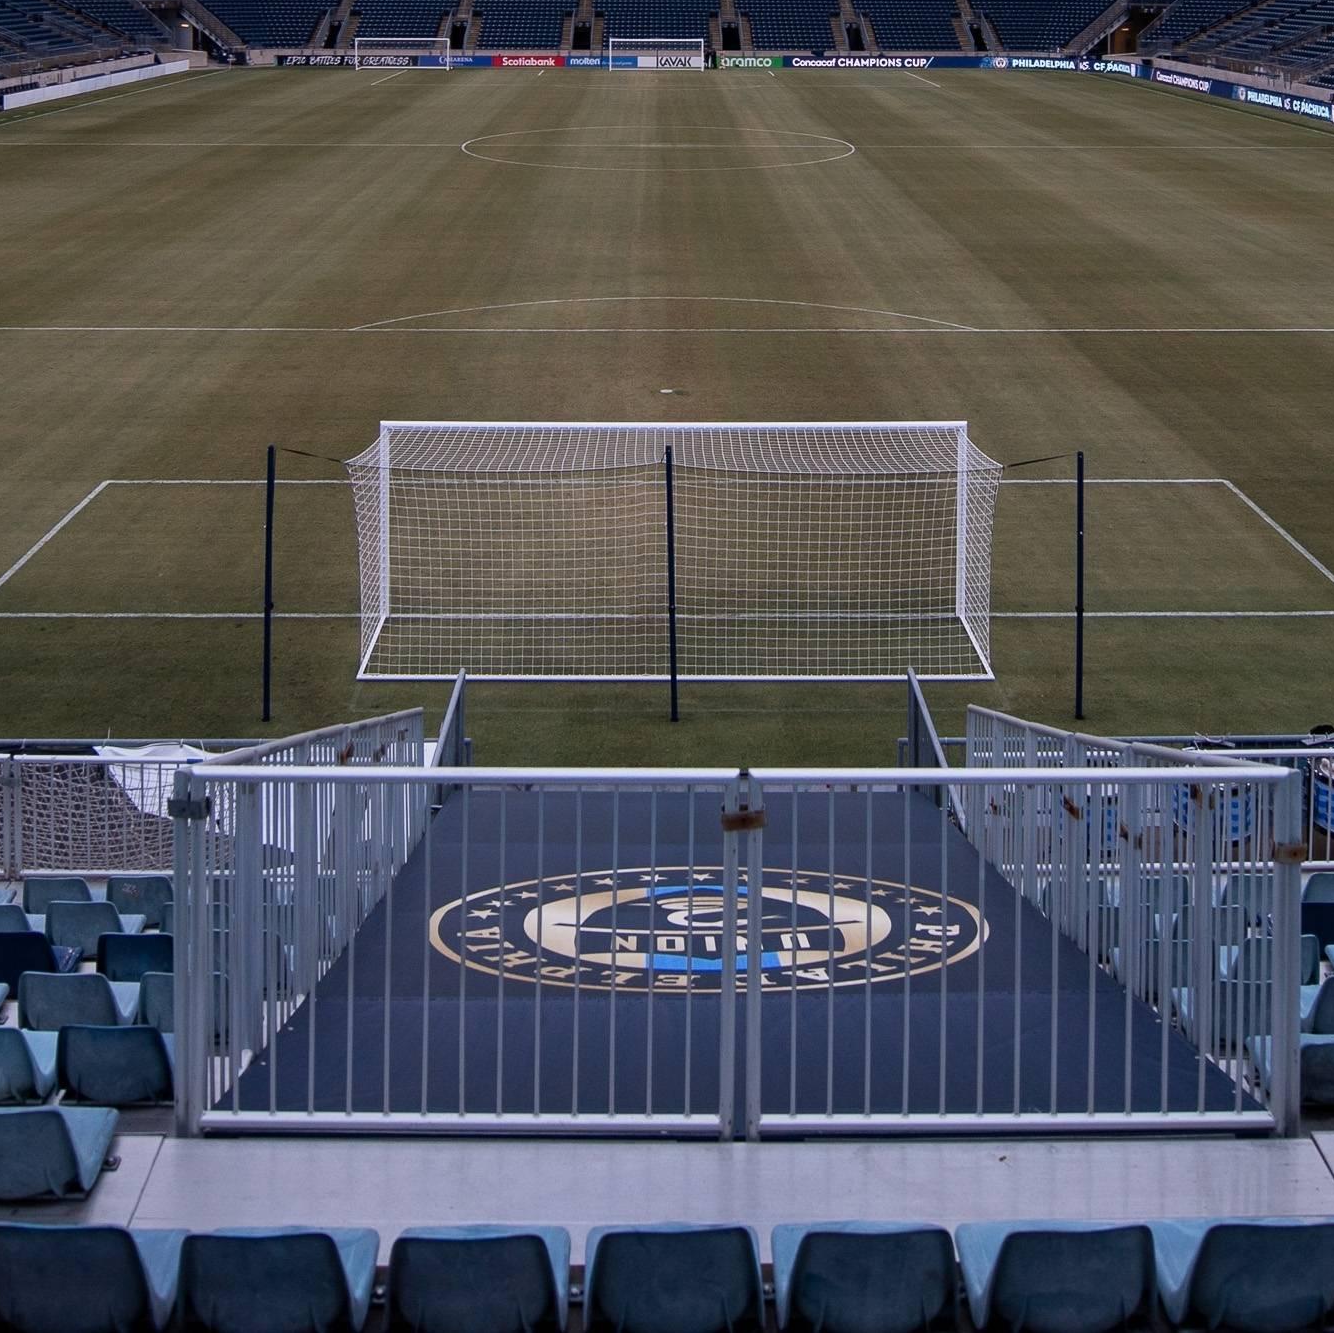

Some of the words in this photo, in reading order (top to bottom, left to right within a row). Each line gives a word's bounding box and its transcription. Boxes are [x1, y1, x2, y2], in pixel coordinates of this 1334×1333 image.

[285, 55, 307, 66] EPIC
[502, 56, 556, 66] Scotiabank
[570, 57, 600, 66] molten
[659, 57, 692, 67] KAVAK
[792, 57, 837, 67] Concacaf
[838, 57, 902, 67] CHAMPIONS
[904, 58, 927, 68] CUP
[1012, 58, 1075, 69] PHILADELPHIA
[1093, 62, 1105, 72] CF
[1172, 75, 1199, 89] CHAMPIONS
[1198, 80, 1210, 92] CUP
[1247, 90, 1283, 108] PHILADELPHIA
[1292, 100, 1301, 112] CF
[1301, 102, 1330, 119] PACHUCA
